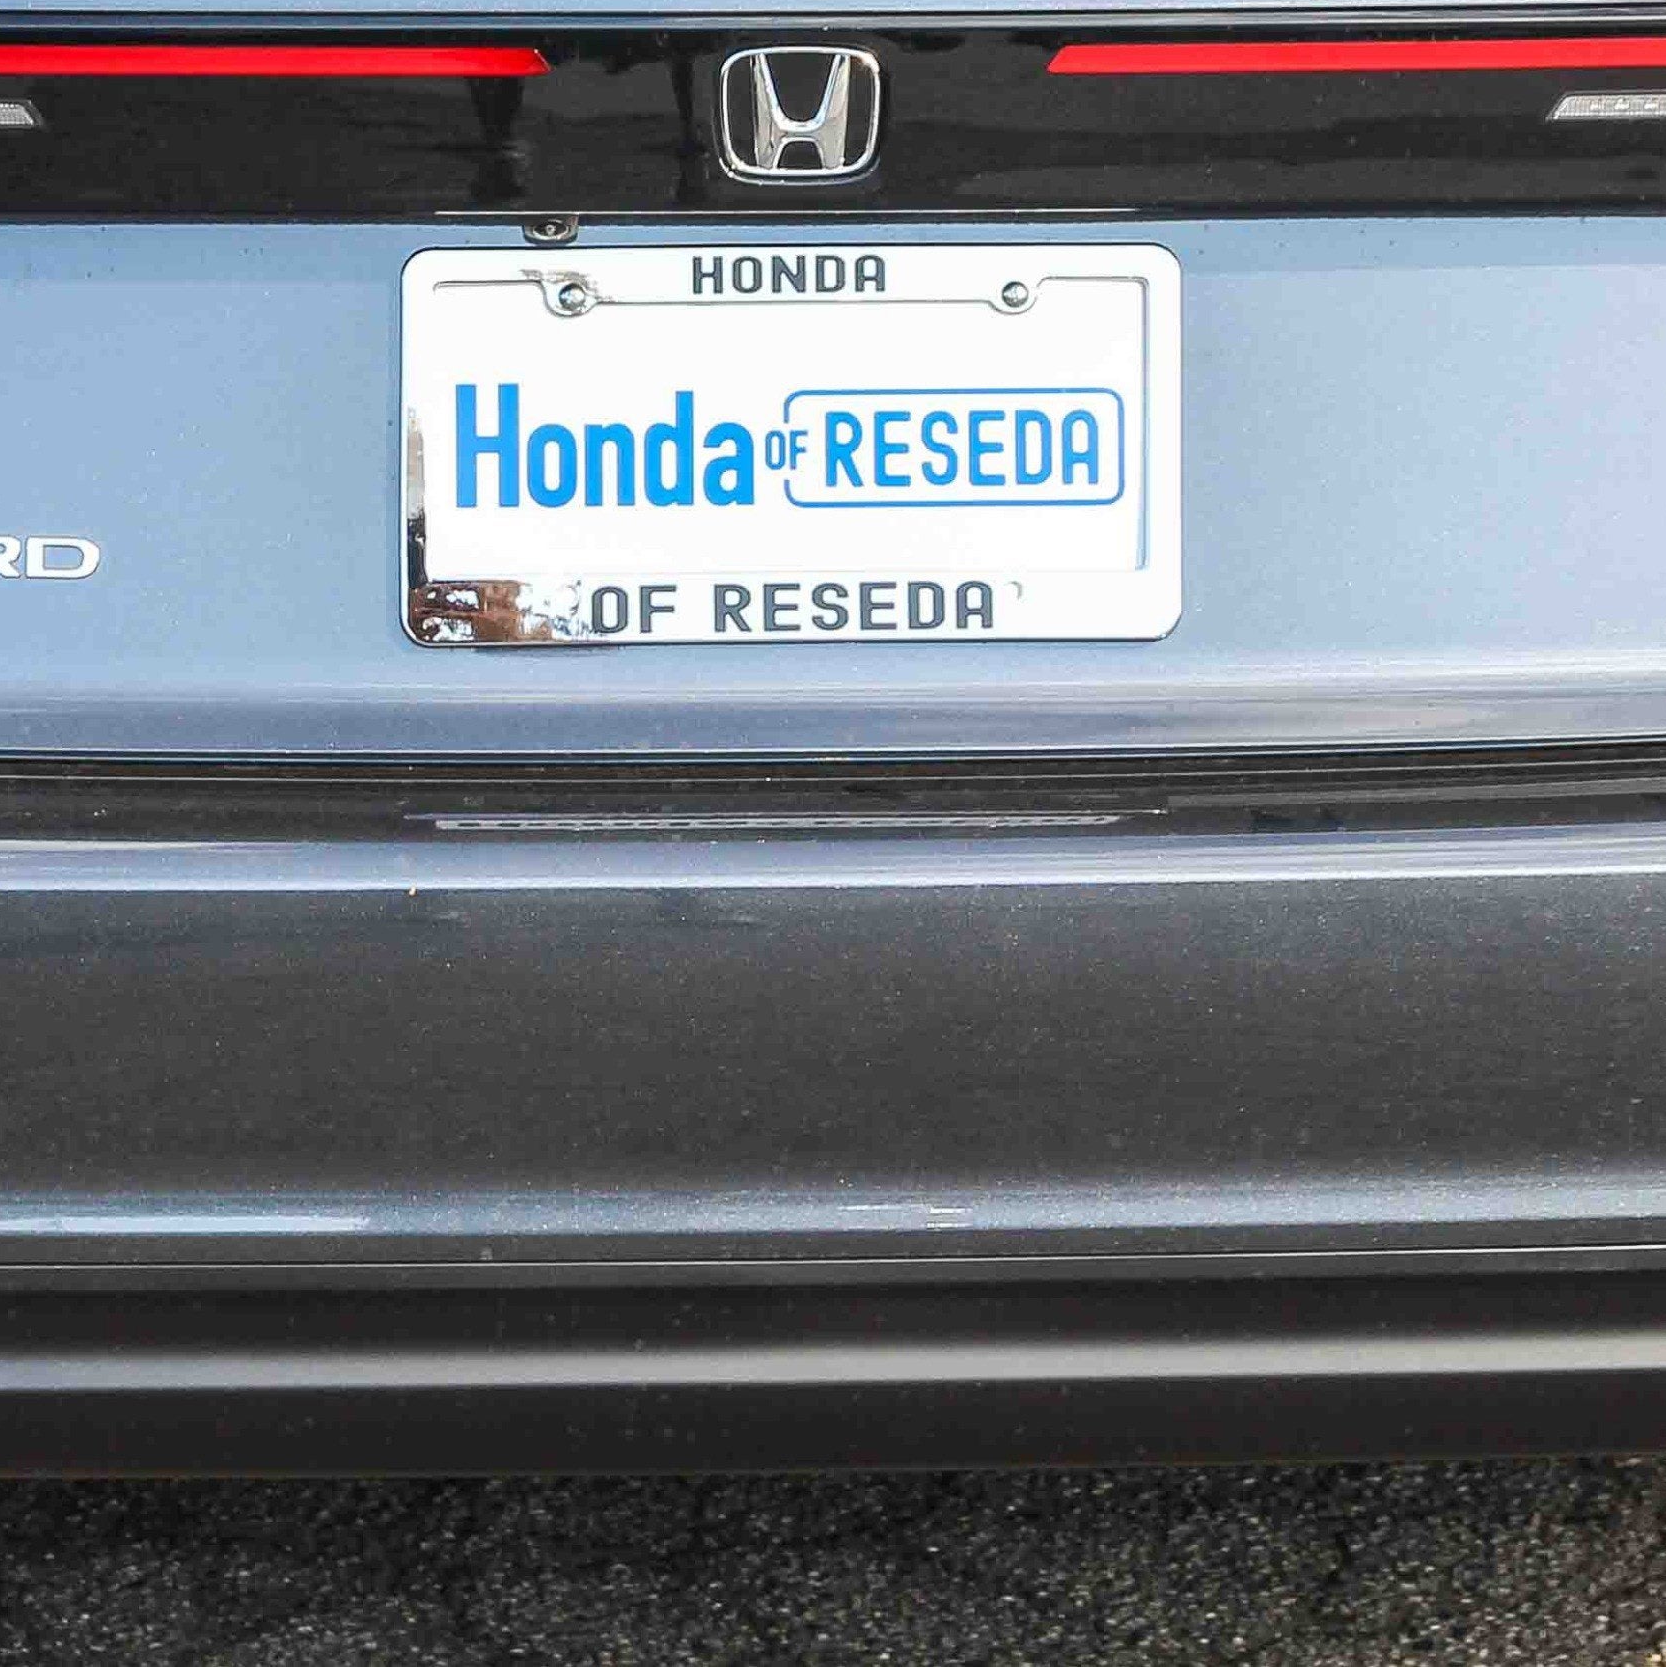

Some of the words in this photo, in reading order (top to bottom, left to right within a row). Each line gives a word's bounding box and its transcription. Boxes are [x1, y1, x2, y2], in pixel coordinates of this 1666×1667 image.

[691, 253, 887, 295] HONDA
[454, 382, 756, 509] Honda
[764, 429, 808, 472] OF
[823, 408, 1101, 490] RESEDA
[589, 584, 678, 636] OF
[713, 579, 995, 634] RESEDA
